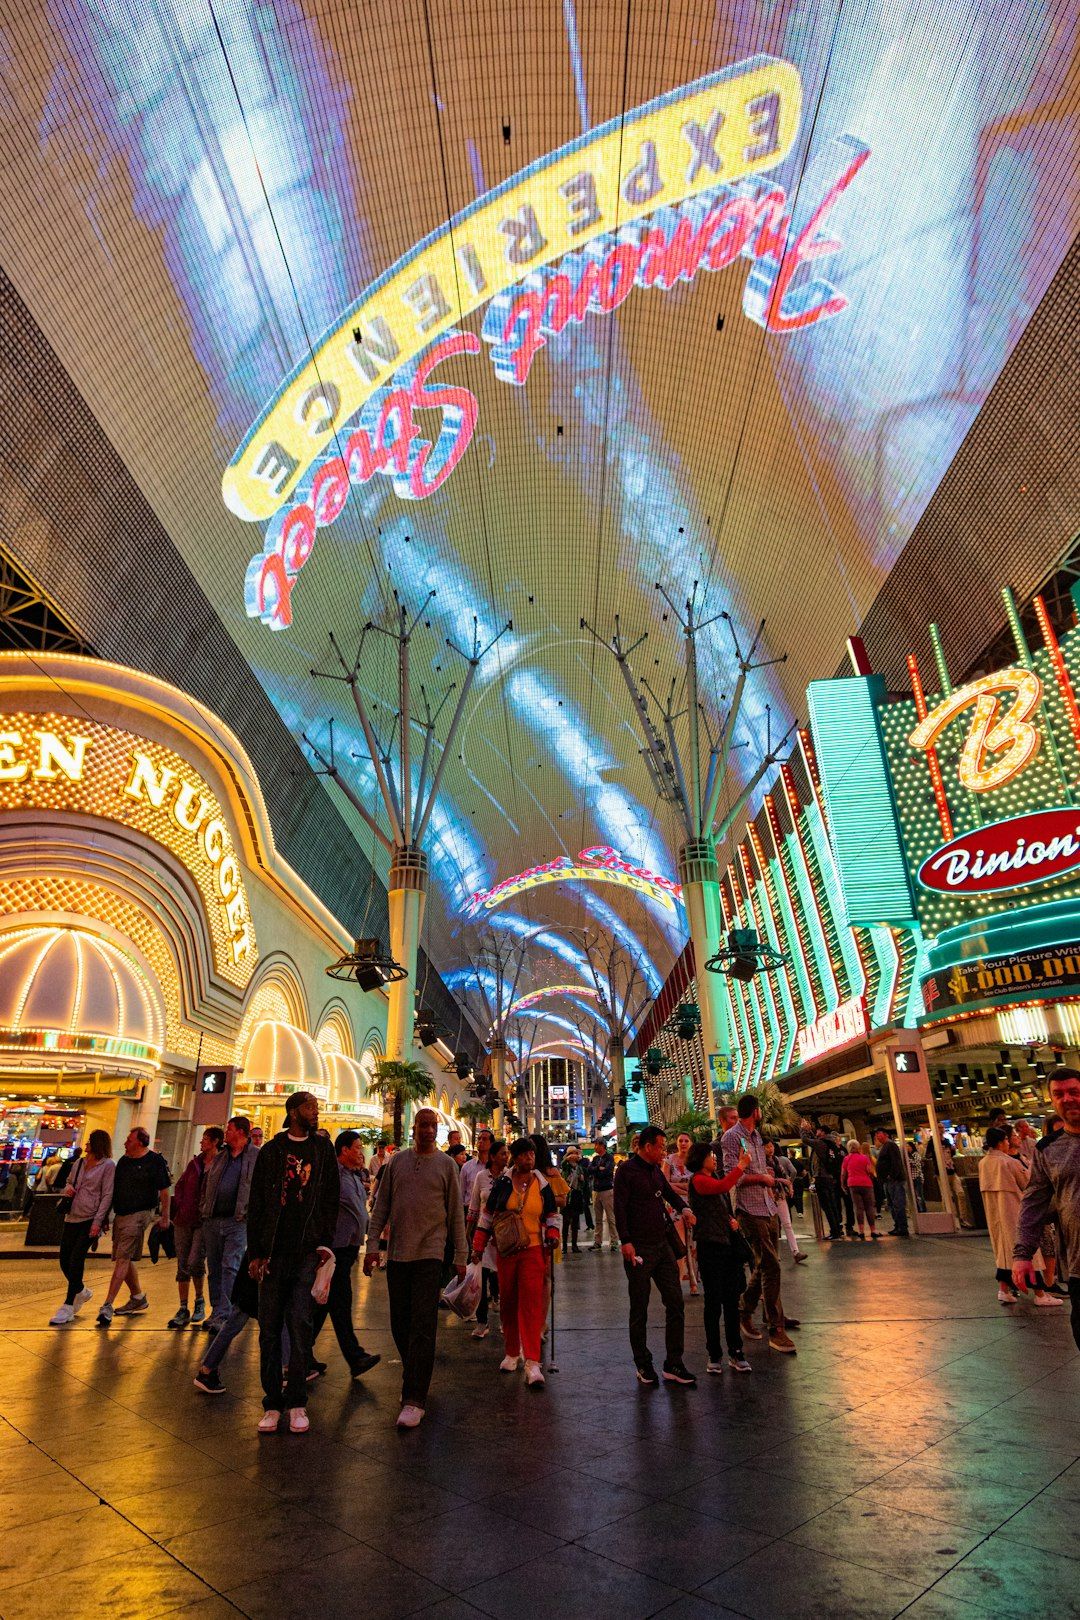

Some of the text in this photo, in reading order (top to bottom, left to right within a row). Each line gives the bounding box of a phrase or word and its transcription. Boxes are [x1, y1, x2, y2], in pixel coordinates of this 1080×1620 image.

[255, 89, 781, 495] EXPERIENCE
[245, 132, 871, 630] Fremont Street
[909, 667, 1042, 791] B
[120, 751, 253, 964] NUGGET
[489, 869, 665, 905] EXPERIENCE
[958, 966, 979, 976] Take
[982, 959, 1007, 970] Your
[1009, 952, 1053, 965] Picture
[983, 989, 994, 997] See
[994, 986, 1008, 996] Club
[1008, 984, 1030, 993] Binion's
